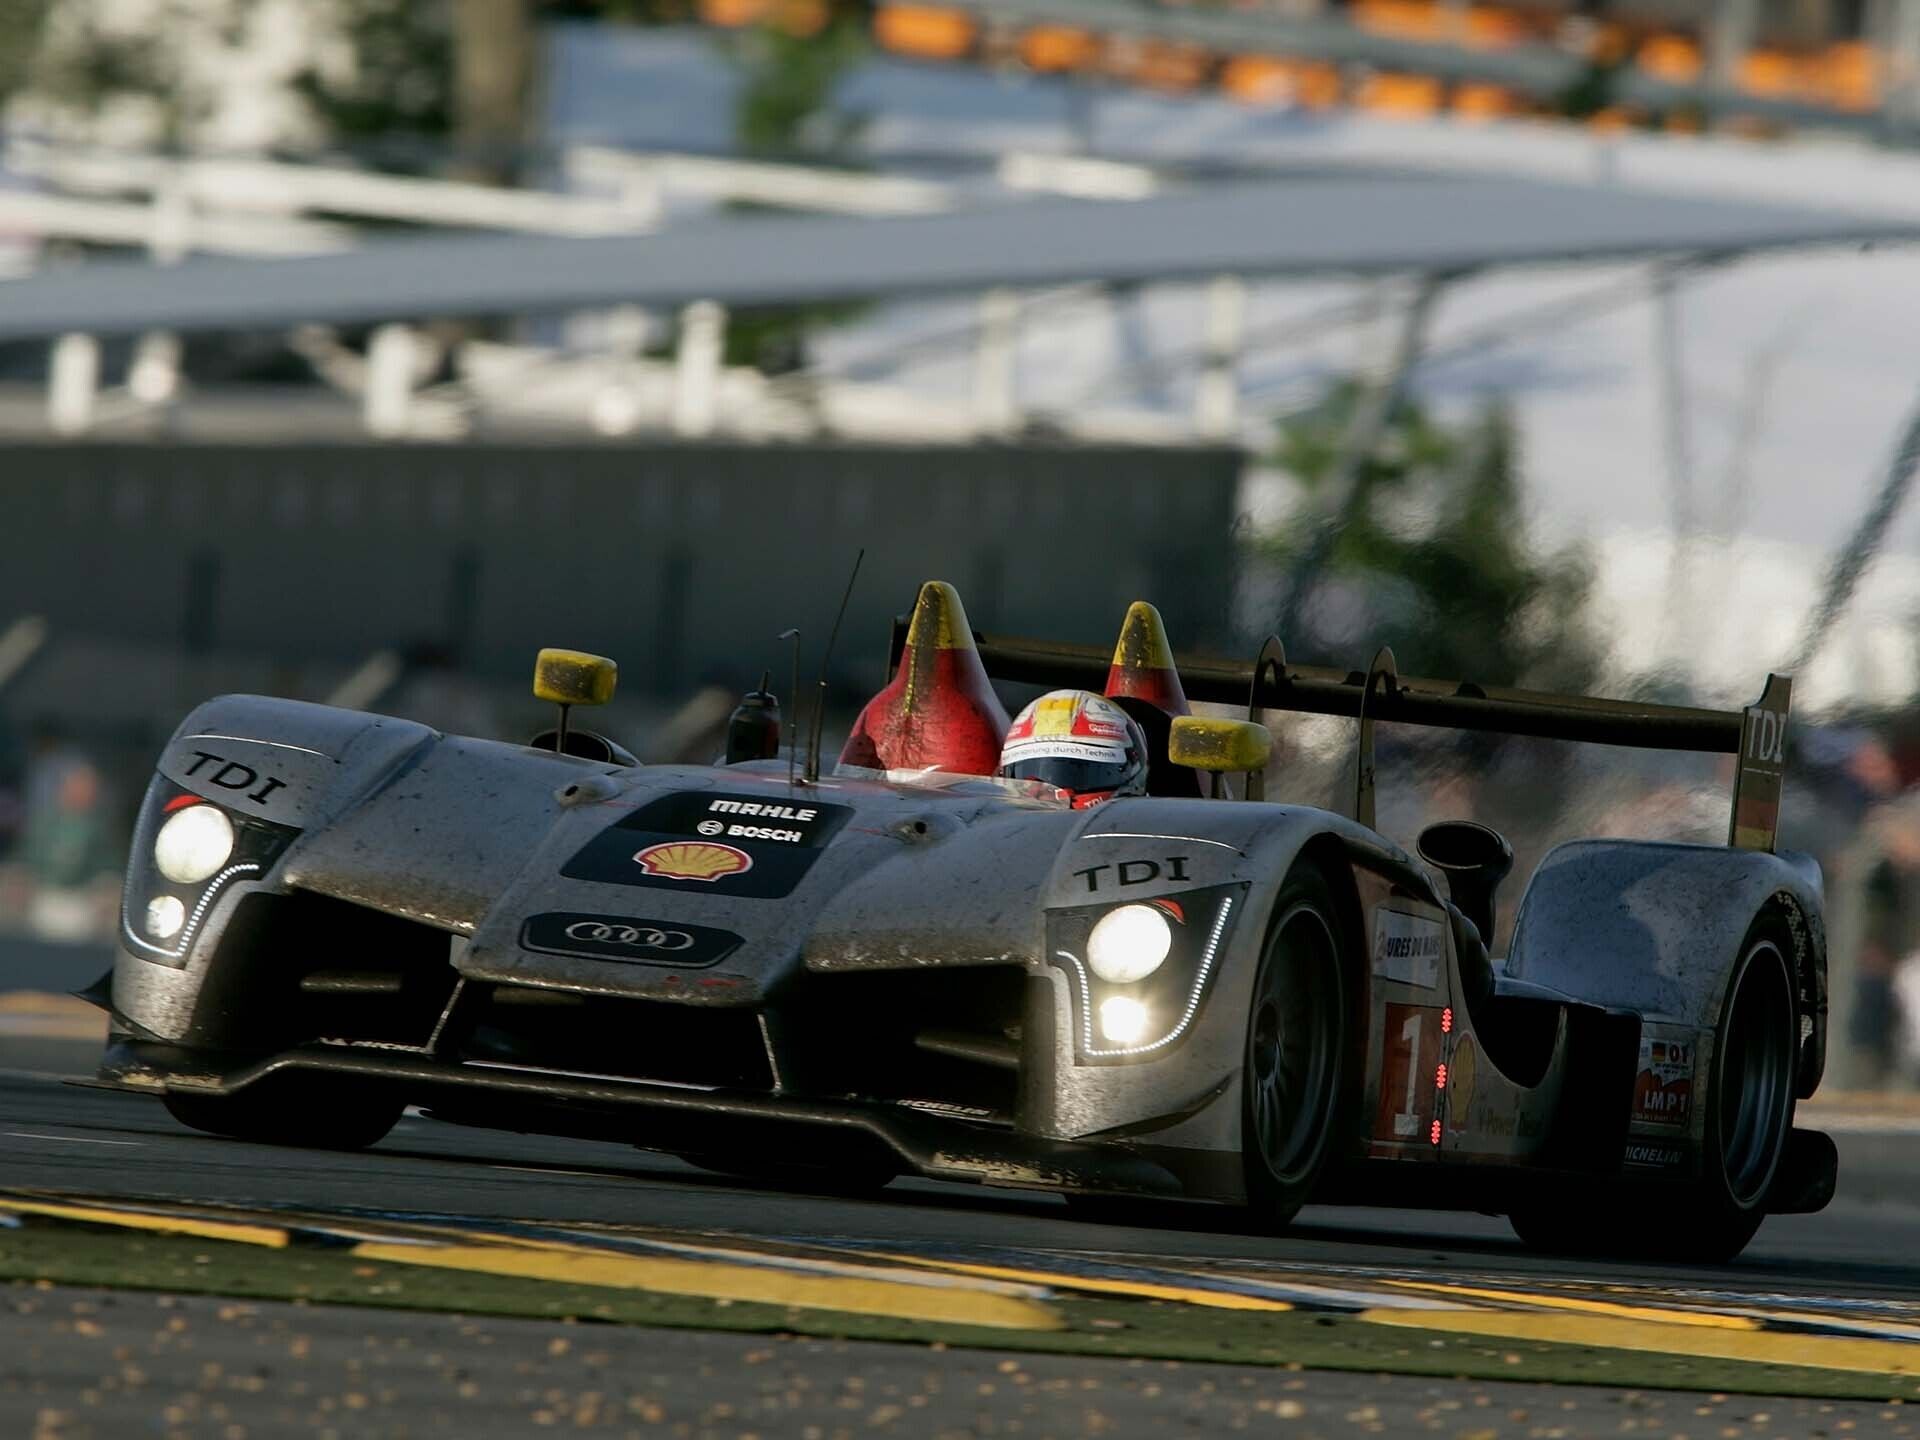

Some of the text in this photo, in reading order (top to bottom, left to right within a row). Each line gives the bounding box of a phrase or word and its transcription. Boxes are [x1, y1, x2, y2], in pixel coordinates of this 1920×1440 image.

[1053, 746, 1081, 755] durch
[1085, 749, 1116, 759] Technik
[1748, 707, 1788, 763] TDI
[185, 751, 288, 805] TDI
[709, 799, 817, 822] MAHLE
[727, 824, 802, 843] BOSCH
[1074, 856, 1190, 892] TDI
[1394, 1014, 1421, 1137] 1
